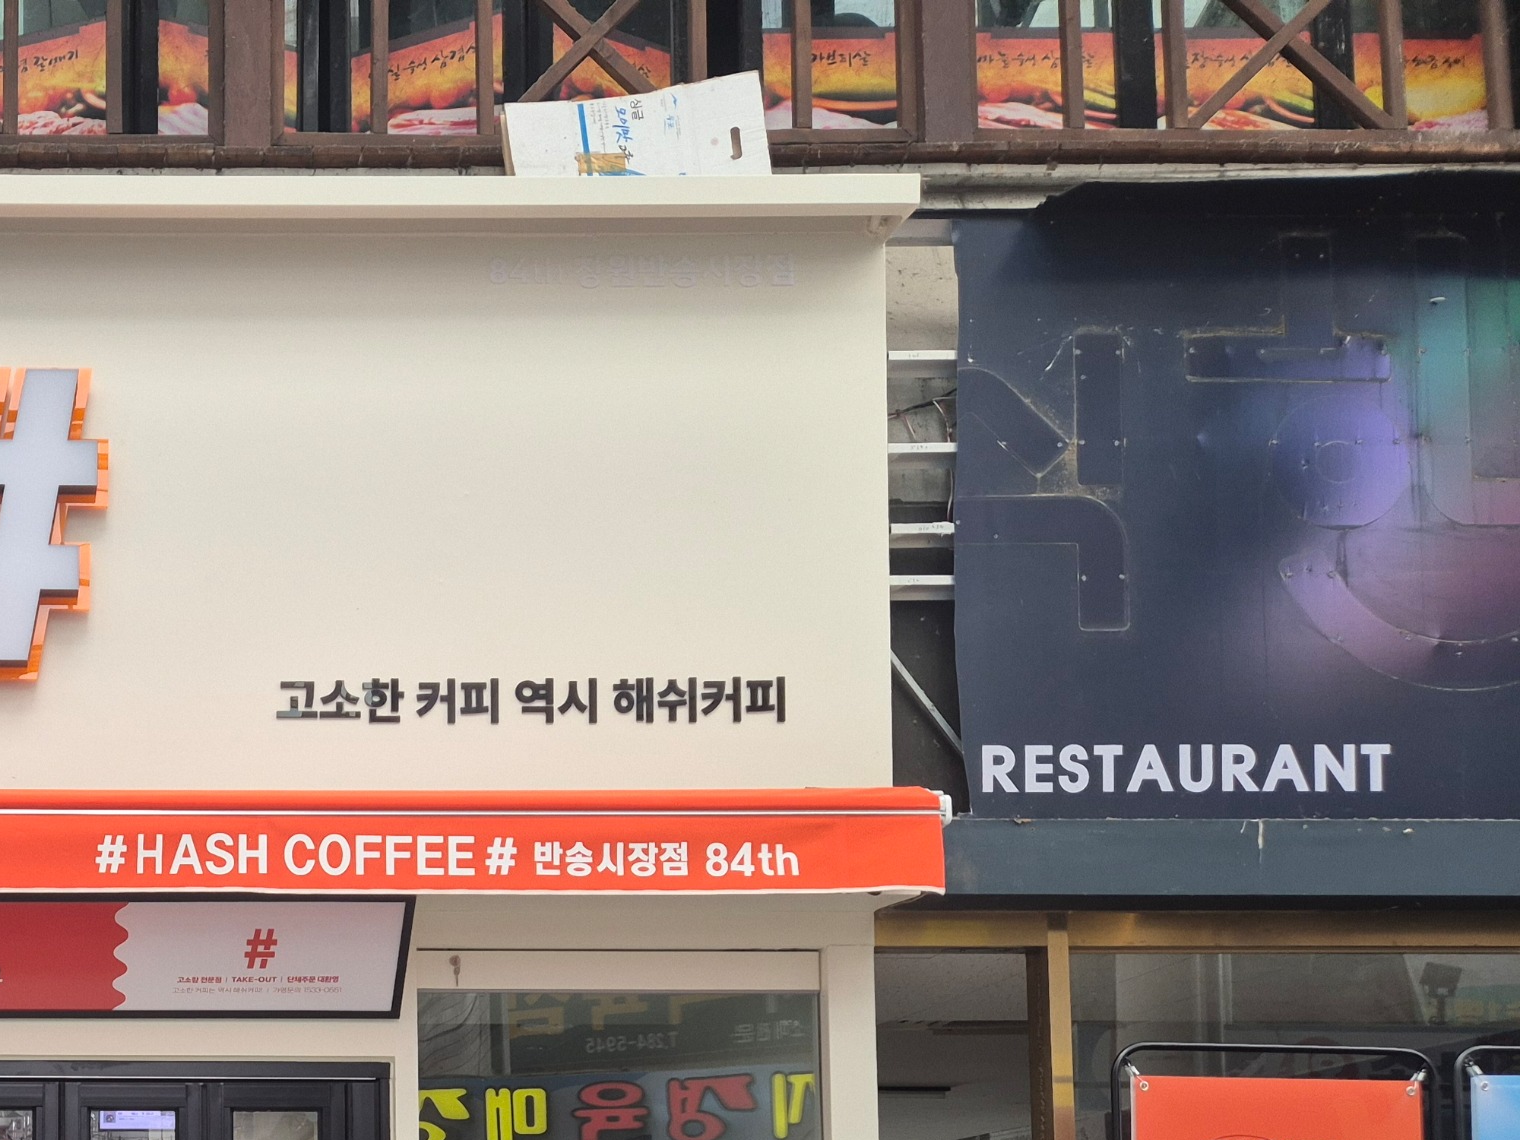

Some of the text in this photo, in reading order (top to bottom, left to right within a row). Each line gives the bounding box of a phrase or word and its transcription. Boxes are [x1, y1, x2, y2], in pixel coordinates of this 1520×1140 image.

[276, 677, 786, 724] 고소한 커피 역시 해쉬커피
[981, 743, 1392, 793] RESTAURANT
[284, 834, 476, 876] COFFEE
[533, 841, 688, 878] 반송시장점
[705, 841, 800, 876] 84th
